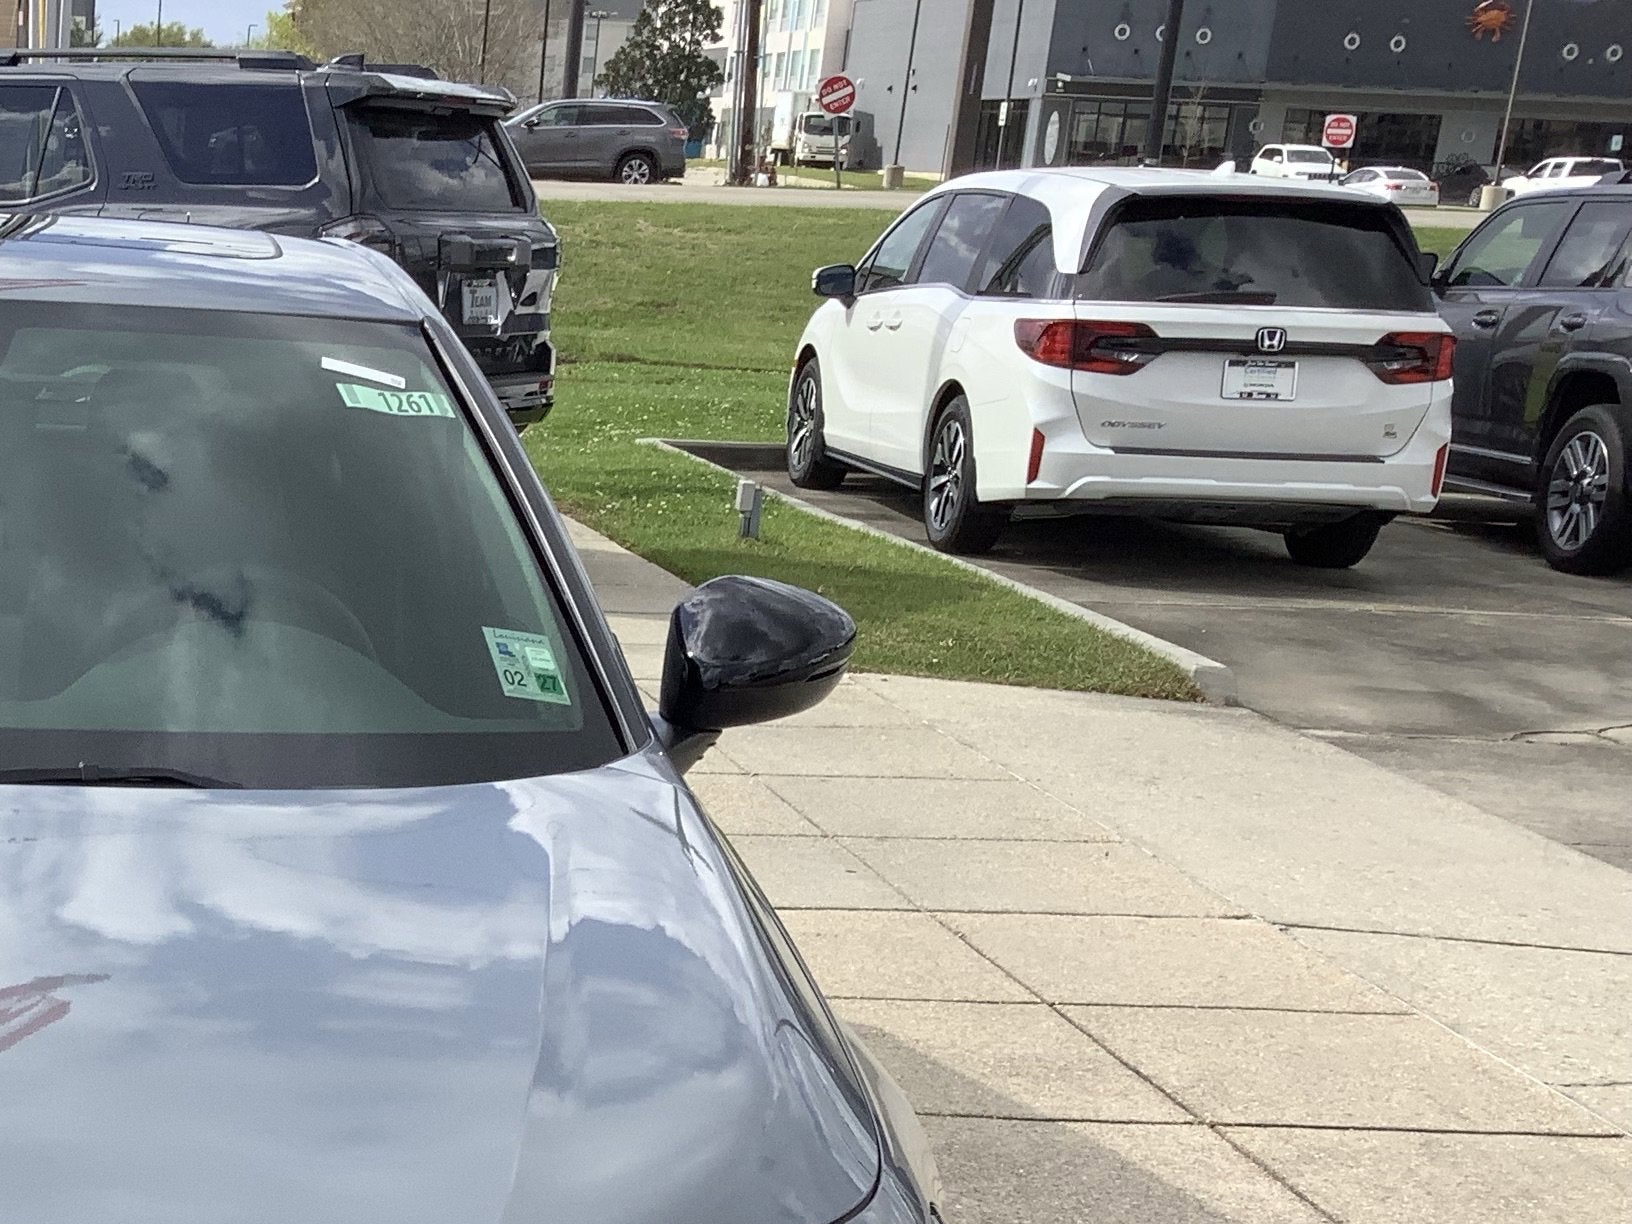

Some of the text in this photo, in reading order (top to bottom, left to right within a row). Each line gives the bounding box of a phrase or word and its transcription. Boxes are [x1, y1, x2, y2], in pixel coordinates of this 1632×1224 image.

[822, 80, 848, 95] DO NOT
[829, 96, 851, 110] ENTER
[378, 392, 435, 414] 1261
[1101, 420, 1167, 430] ODYSSEY
[503, 669, 528, 687] 02
